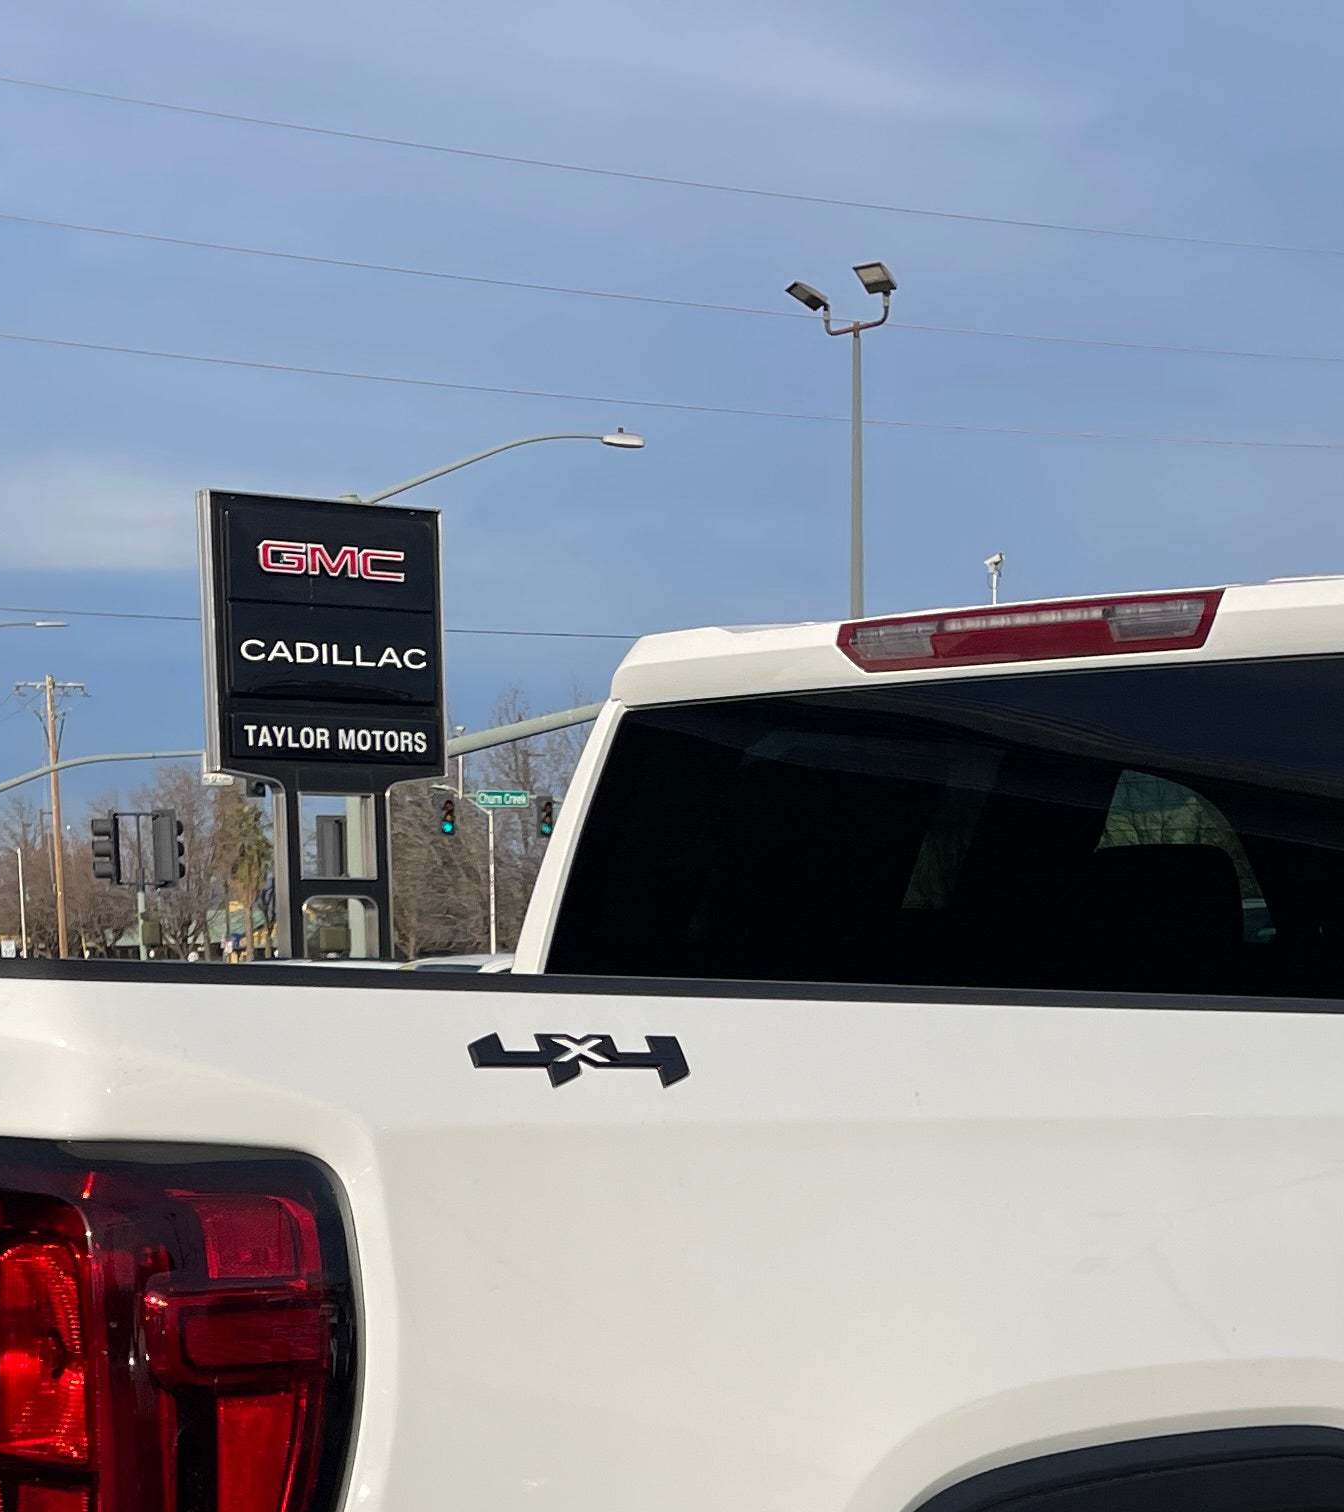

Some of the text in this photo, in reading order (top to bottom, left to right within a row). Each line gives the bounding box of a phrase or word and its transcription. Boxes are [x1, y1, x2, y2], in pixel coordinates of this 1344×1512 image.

[257, 539, 405, 583] GMC
[240, 639, 427, 669] CADILLAC
[243, 724, 427, 753] TAYLOR MOTORS
